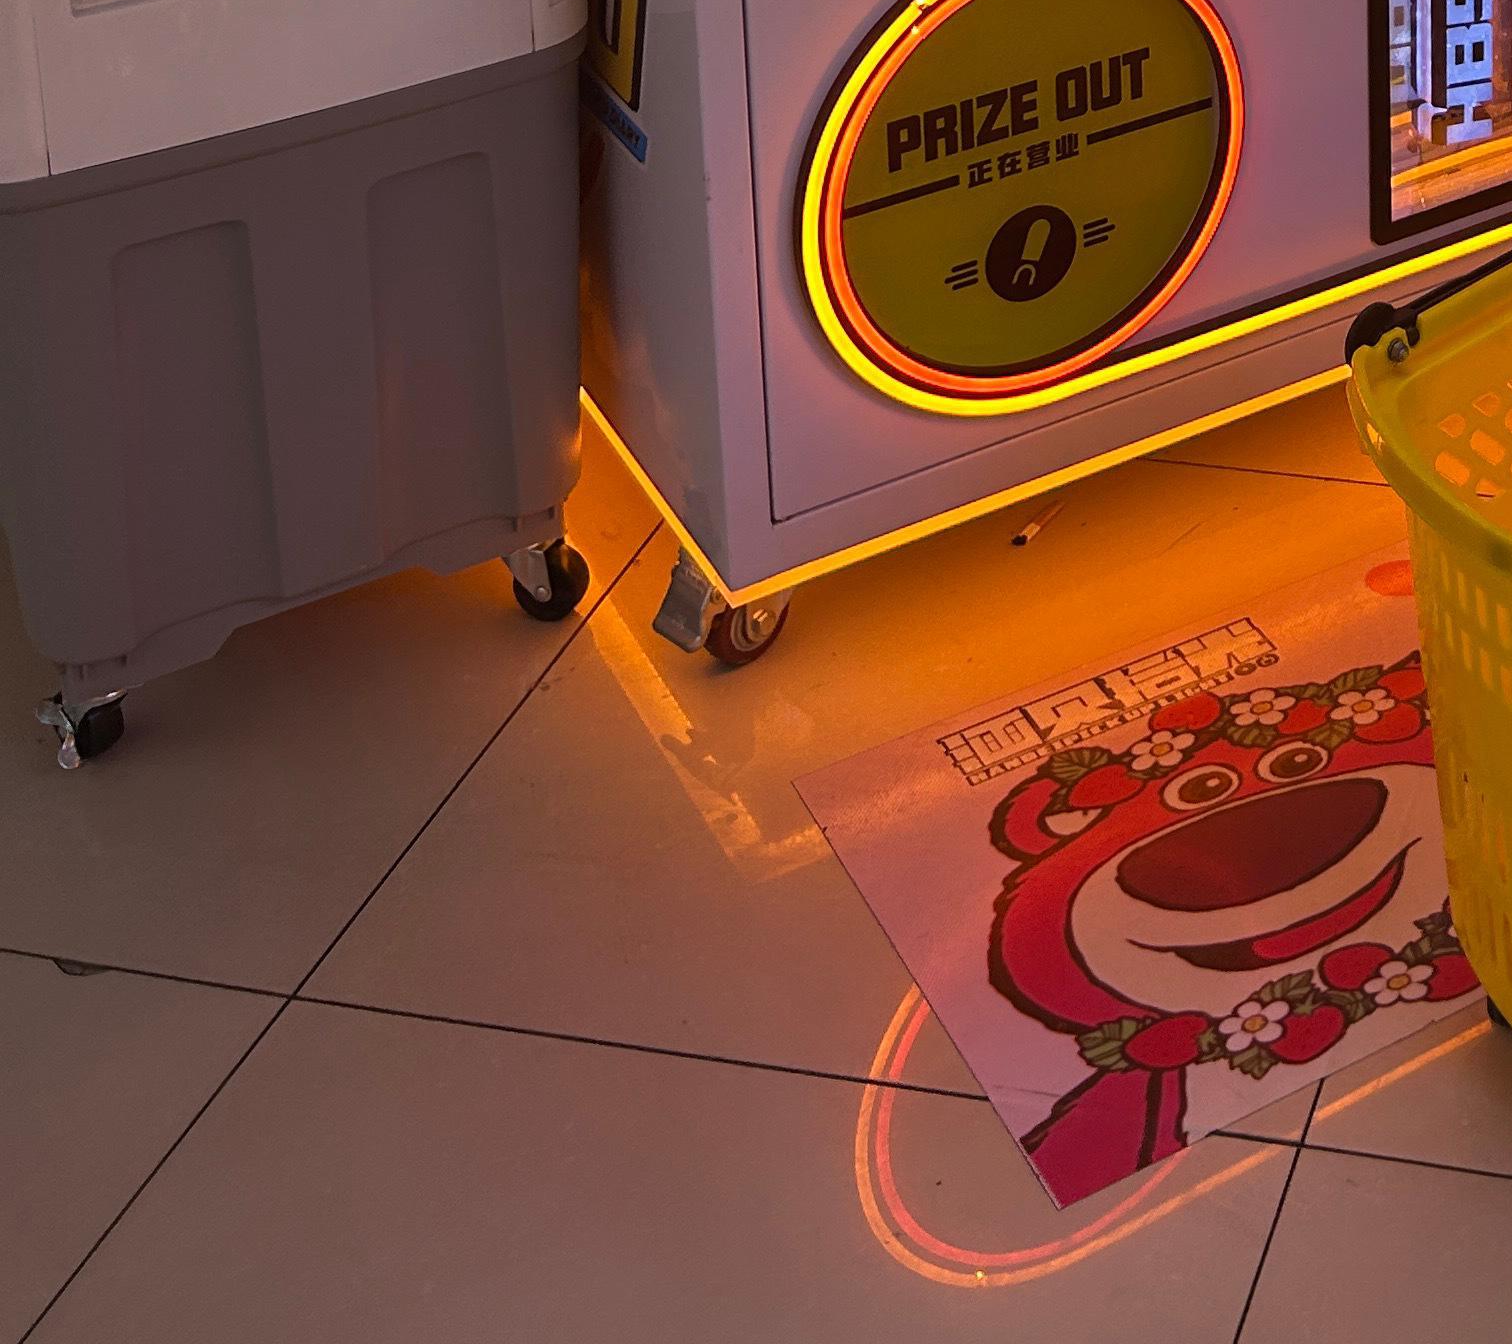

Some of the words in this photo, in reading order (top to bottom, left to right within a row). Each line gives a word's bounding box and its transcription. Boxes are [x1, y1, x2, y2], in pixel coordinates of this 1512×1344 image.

[886, 79, 1040, 174] PRIZE
[1055, 47, 1151, 123] OUT
[967, 130, 1080, 189] 正在营业
